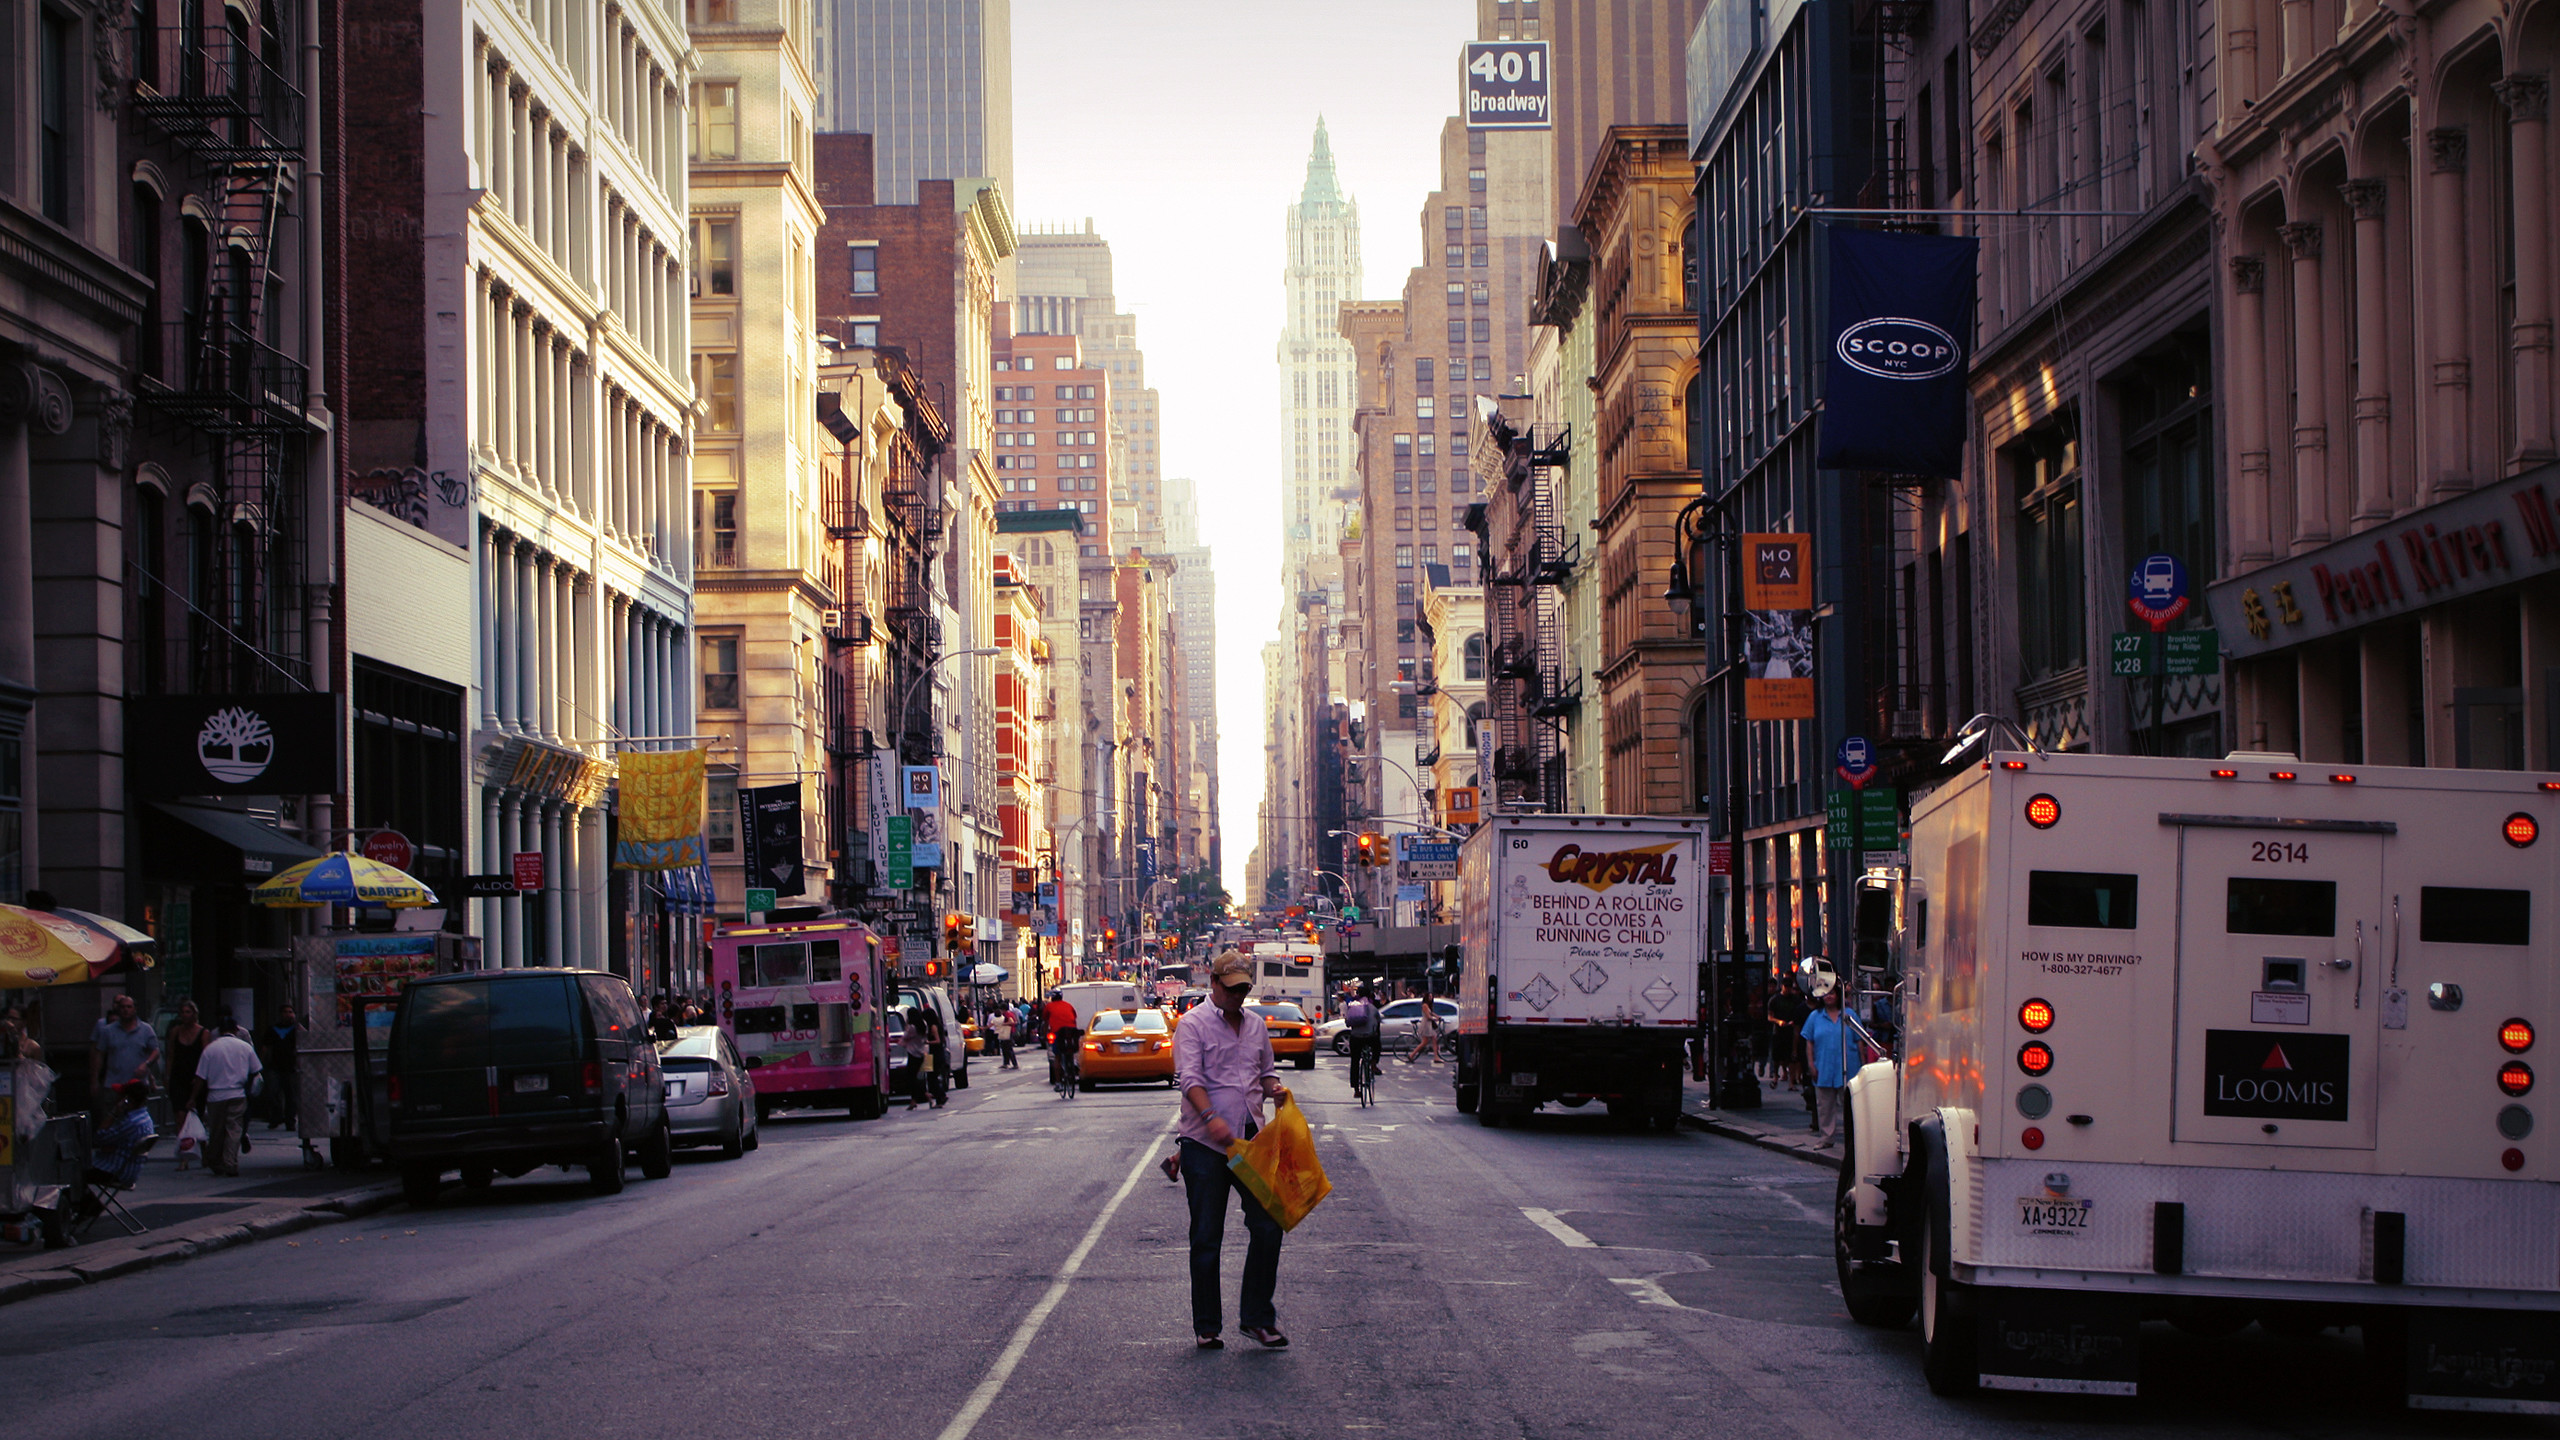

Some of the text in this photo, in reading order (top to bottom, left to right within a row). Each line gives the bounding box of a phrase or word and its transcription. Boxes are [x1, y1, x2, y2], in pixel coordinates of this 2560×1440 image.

[1470, 51, 1540, 82] 401
[1471, 89, 1546, 117] Broadway
[1850, 338, 1948, 359] SCOOP
[1884, 359, 1908, 368] NYC
[1761, 549, 1791, 562] MO
[1763, 566, 1791, 578] CA
[2310, 540, 2403, 622] Pearl
[2400, 523, 2510, 593] River
[2132, 599, 2184, 619] NO STANDING
[2168, 643, 2179, 652] Bay
[741, 794, 754, 848] PREPARING
[368, 841, 405, 851] Jewelry
[1512, 840, 1529, 849] 60
[2252, 841, 2309, 863] 2614
[1549, 844, 1678, 885] CRYSTAL
[254, 887, 294, 898] SABRETT
[359, 886, 417, 898] SABRETT
[472, 881, 514, 891] ALDO
[1645, 885, 1673, 896] Says
[1595, 896, 1607, 910] A
[1612, 897, 1684, 912] ROLLING
[1031, 919, 1044, 927] 30
[1542, 912, 1663, 927] BALL COMES A
[1536, 928, 1611, 943] RUNNING
[1569, 946, 1664, 960] Please Drive Safely
[2021, 952, 2142, 965] HOW IS MY DRIVING?
[2041, 964, 2123, 975] 1-800-327-4677
[771, 1029, 818, 1042] YOGO
[2217, 1074, 2335, 1105] LOOMIS
